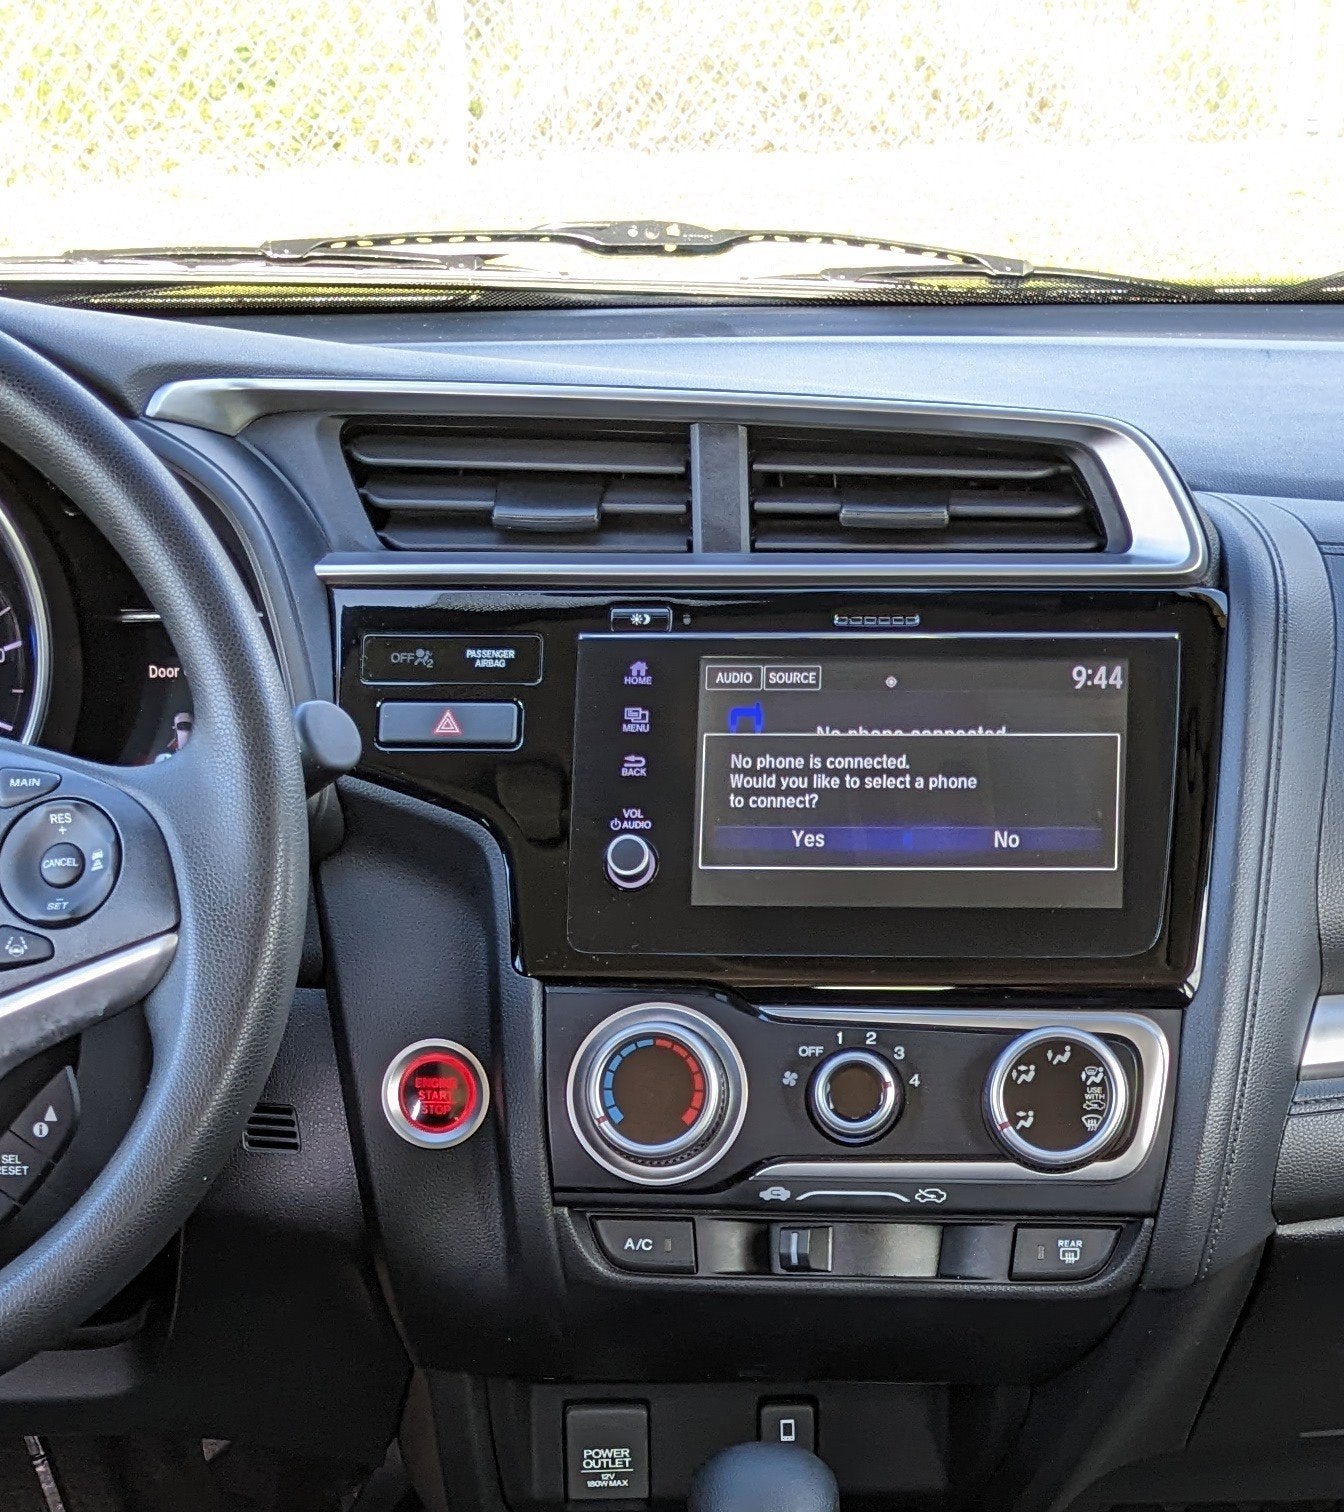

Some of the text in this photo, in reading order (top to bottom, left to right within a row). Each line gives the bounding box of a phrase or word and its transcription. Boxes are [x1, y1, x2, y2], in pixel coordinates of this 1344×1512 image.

[390, 652, 414, 663] OFF
[466, 649, 515, 658] PASSENGER
[475, 659, 505, 668] AIRBAG
[149, 665, 180, 678] Door
[1072, 665, 1123, 689] 9:44
[624, 676, 652, 685] HOME
[716, 672, 753, 684] AUDIO
[768, 672, 817, 684] SOURCE
[622, 723, 649, 732] MENU
[730, 753, 910, 771] No phone is connected.
[621, 767, 647, 777] BACK
[9, 778, 41, 787] MAIN
[730, 774, 977, 791] Would you like to select a phone
[729, 794, 818, 808] to connect?
[49, 813, 72, 824] RES
[623, 809, 643, 818] VOL
[622, 820, 652, 830] AUDIO
[791, 830, 825, 847] Yes
[994, 830, 1020, 848] No
[43, 858, 78, 868] CANCEL
[47, 902, 69, 910] SET
[836, 1031, 843, 1045] 1
[865, 1031, 877, 1045] 2
[798, 1046, 824, 1057] OFF
[893, 1046, 905, 1060] 3
[415, 1077, 457, 1088] ENGINE
[908, 1073, 921, 1087] 4
[418, 1090, 452, 1100] START
[421, 1104, 451, 1115] STOP
[1, 1154, 22, 1164] SEL
[623, 1237, 653, 1250] A/C
[1057, 1239, 1082, 1247] REAR
[583, 1448, 630, 1459] POWER
[582, 1458, 632, 1468] OUTLET
